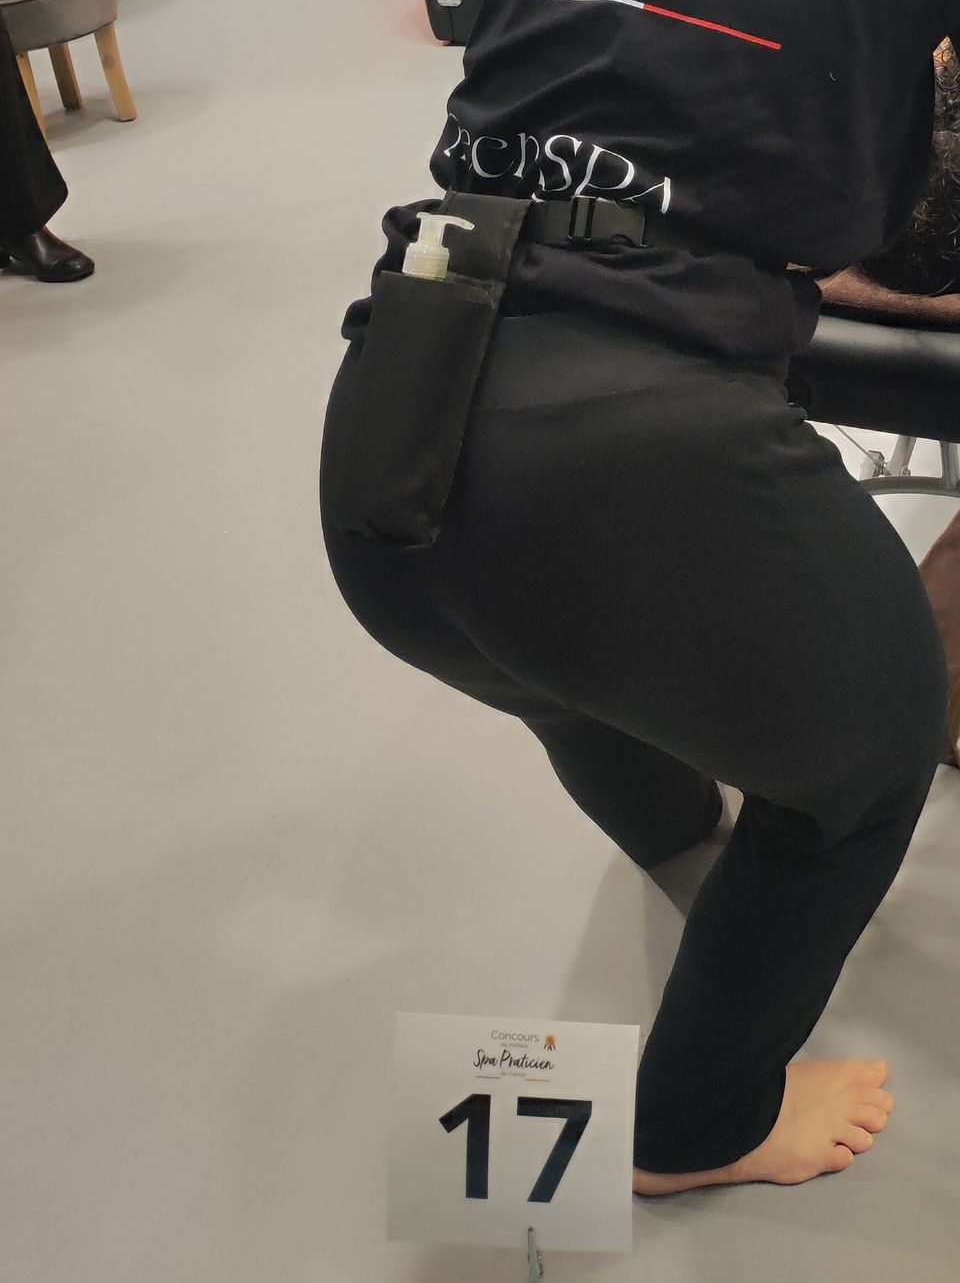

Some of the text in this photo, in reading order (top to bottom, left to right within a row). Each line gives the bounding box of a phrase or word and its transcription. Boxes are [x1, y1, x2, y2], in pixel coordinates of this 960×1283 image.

[490, 1030, 540, 1043] Concours
[473, 1048, 553, 1070] Spa Praticien
[438, 1093, 593, 1203] 17
